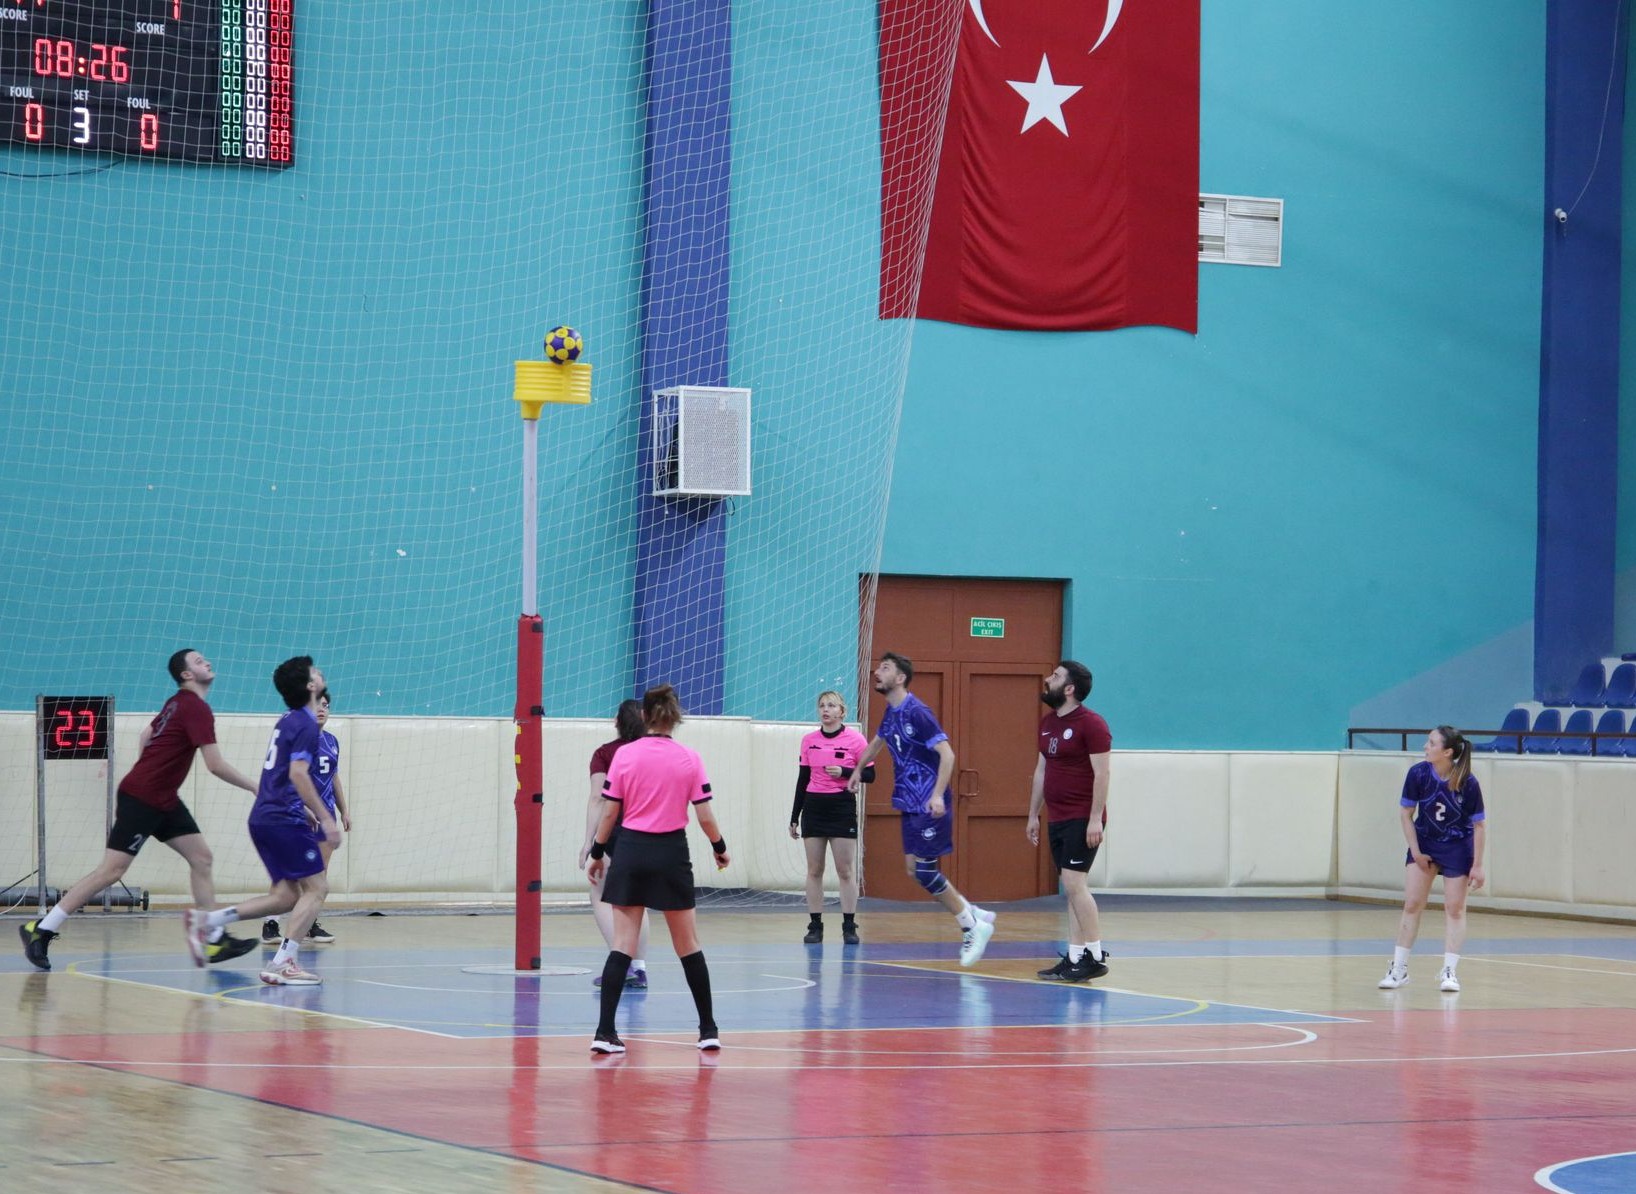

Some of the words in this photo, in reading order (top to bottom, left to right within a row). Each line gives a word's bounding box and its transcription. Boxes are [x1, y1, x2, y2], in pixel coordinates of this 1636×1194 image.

[136, 22, 165, 35] SCORE
[35, 38, 128, 82] 08:26
[10, 86, 34, 99] FOUL
[74, 89, 89, 101] SET
[127, 97, 151, 110] FOUL
[26, 104, 42, 139] 0
[74, 107, 90, 144] 3
[140, 114, 158, 149] 0
[56, 710, 94, 746] 23
[1048, 736, 1058, 754] 18
[319, 756, 330, 774] 5
[1436, 802, 1446, 822] 2
